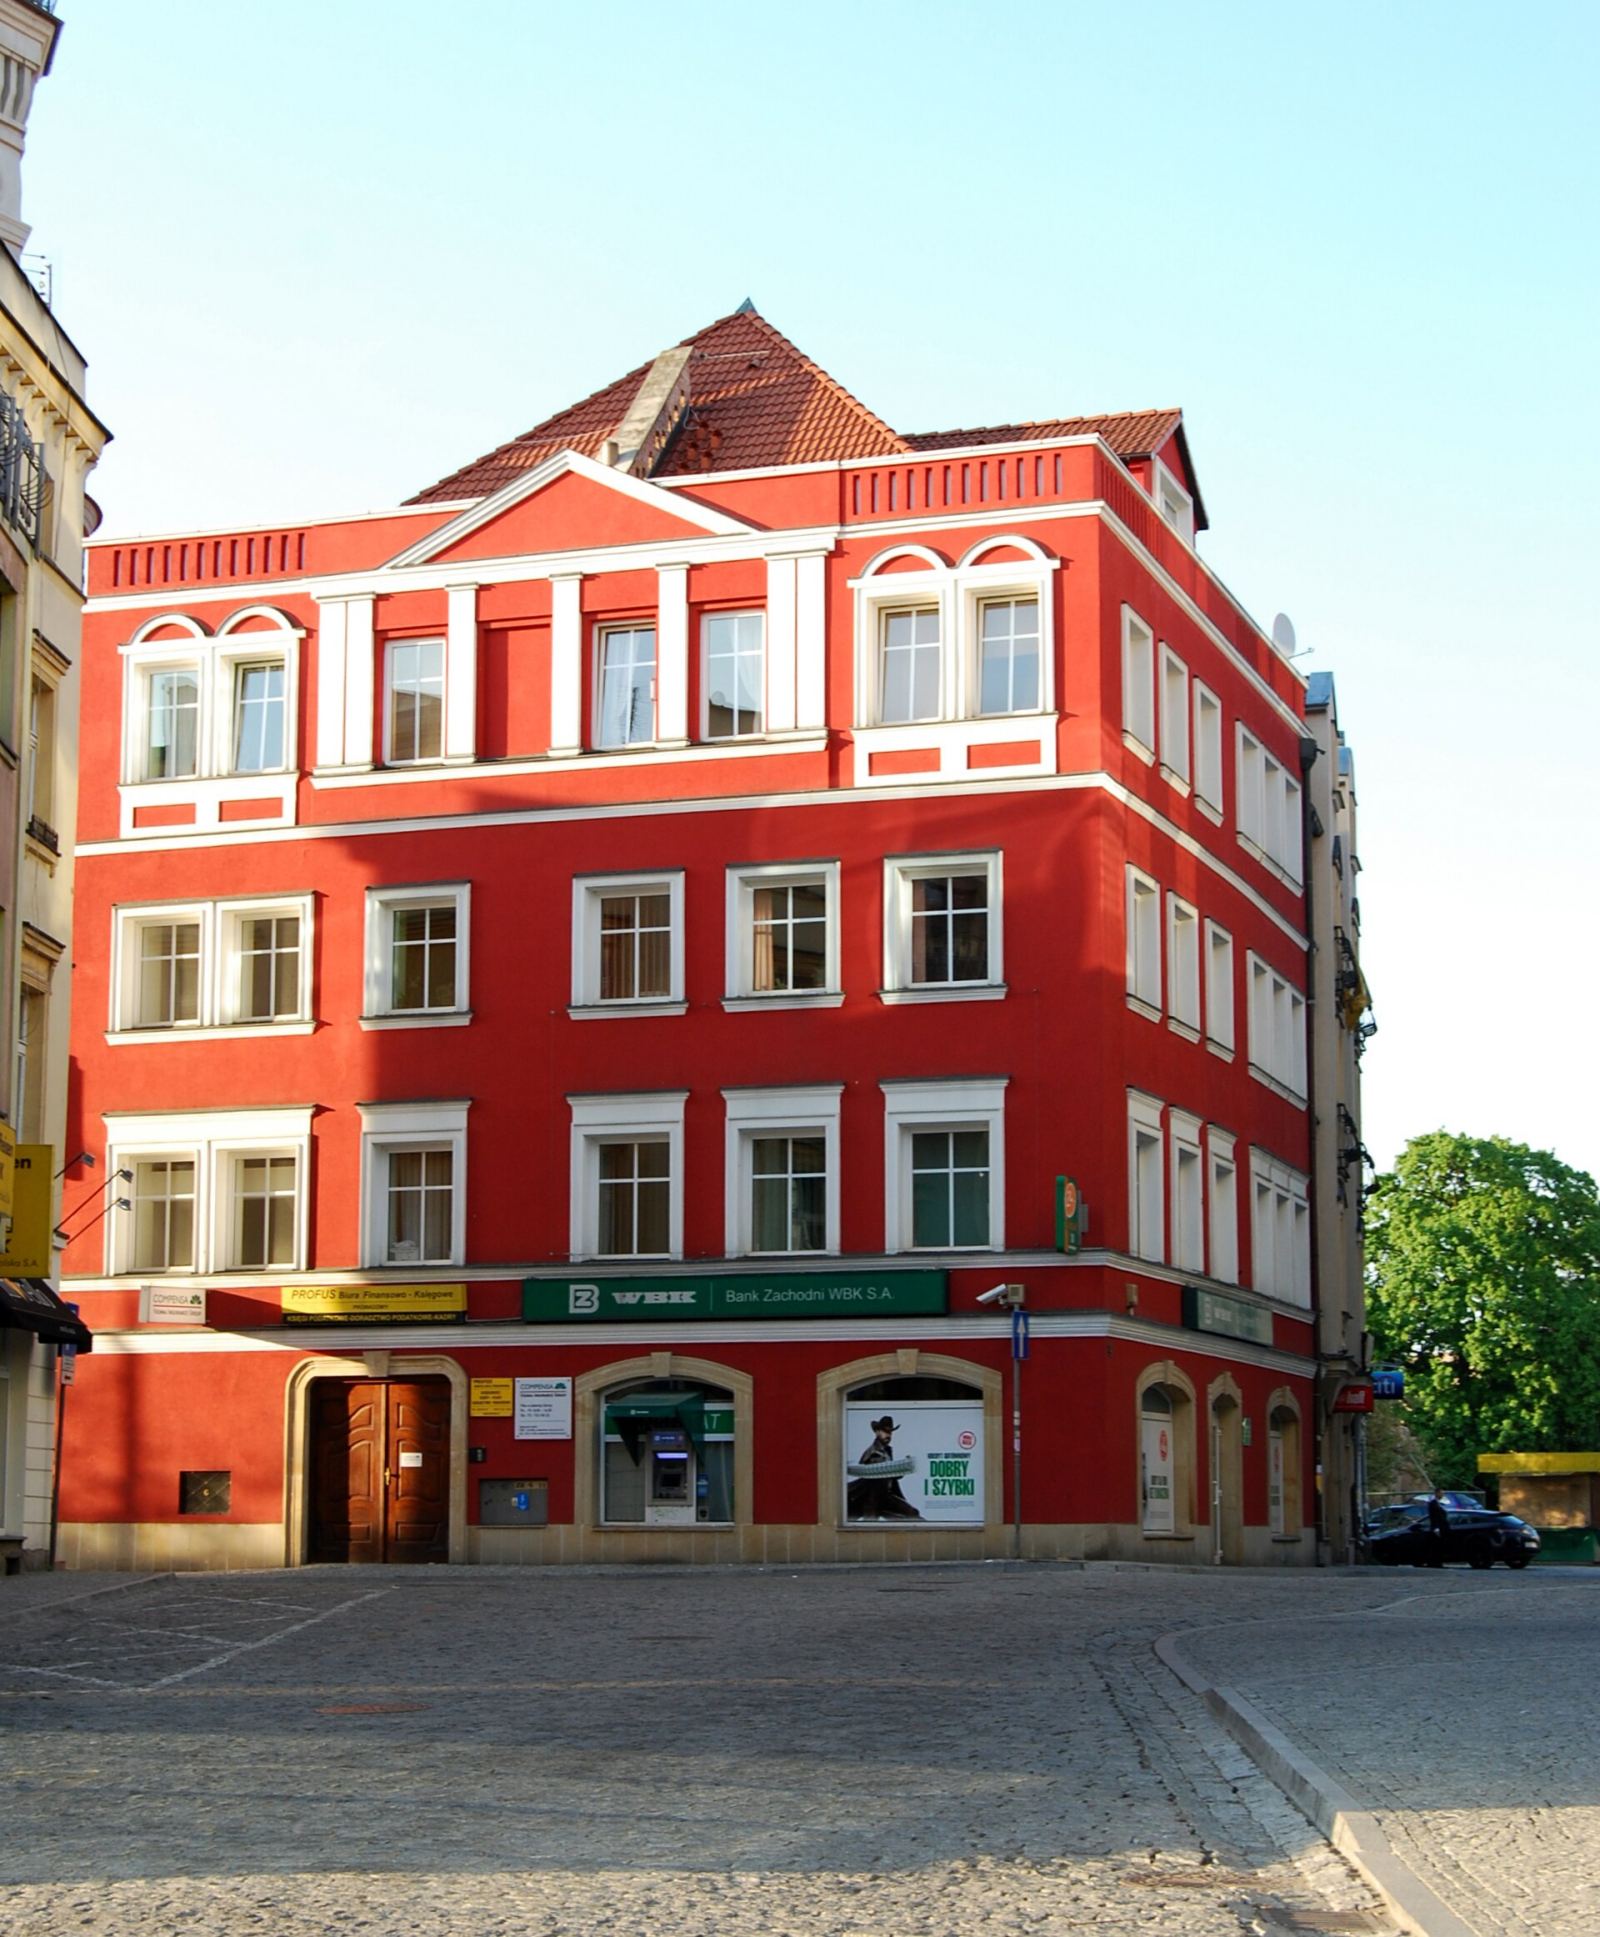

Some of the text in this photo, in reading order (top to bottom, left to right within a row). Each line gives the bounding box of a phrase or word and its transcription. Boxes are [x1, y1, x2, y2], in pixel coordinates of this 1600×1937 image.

[152, 1294, 189, 1305] COMPENSA
[291, 1289, 337, 1300] PROFUS
[362, 1289, 407, 1299] Finansowo
[611, 1291, 697, 1304] WBK
[726, 1289, 760, 1303] Bank
[763, 1288, 825, 1302] Zachodni
[828, 1287, 863, 1300] WBK
[866, 1287, 896, 1300] S.A.
[930, 1460, 969, 1478] DOBRY
[924, 1478, 975, 1496] I SZYBKI
